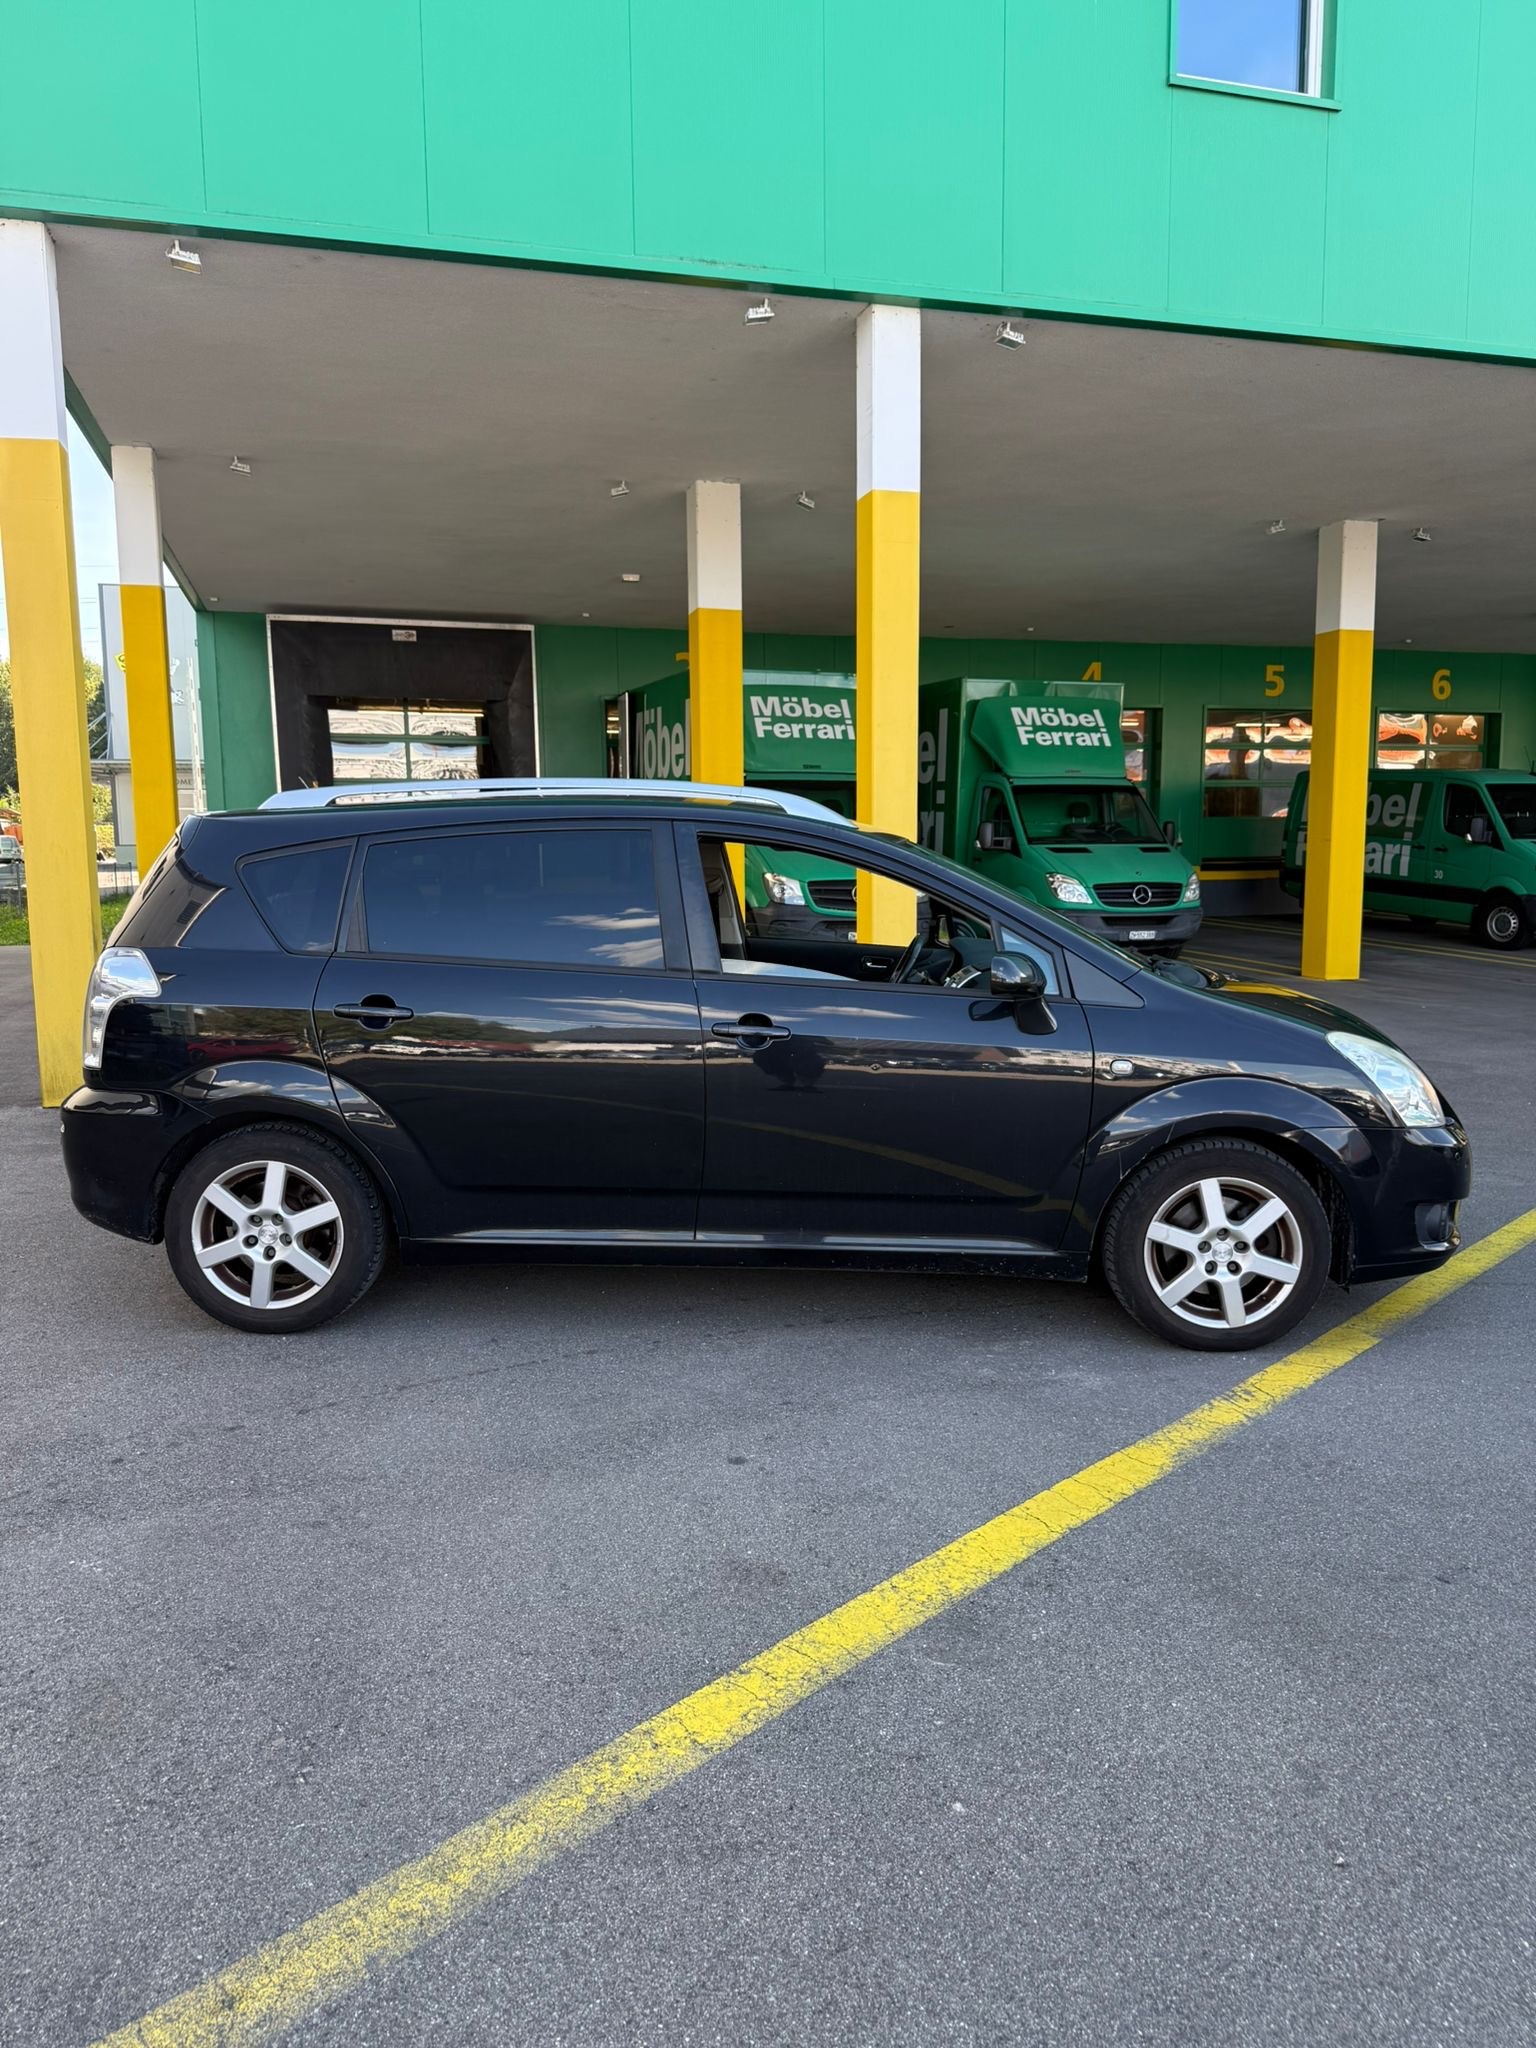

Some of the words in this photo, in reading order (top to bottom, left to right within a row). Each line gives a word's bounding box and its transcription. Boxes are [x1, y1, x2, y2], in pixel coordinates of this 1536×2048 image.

[1264, 665, 1285, 697] 5
[1432, 669, 1451, 700] 6
[750, 695, 852, 718] Möbel
[1010, 706, 1105, 727] Möbel
[754, 717, 856, 740] Ferrari
[1016, 726, 1112, 747] Ferrari
[1434, 870, 1444, 879] 30
